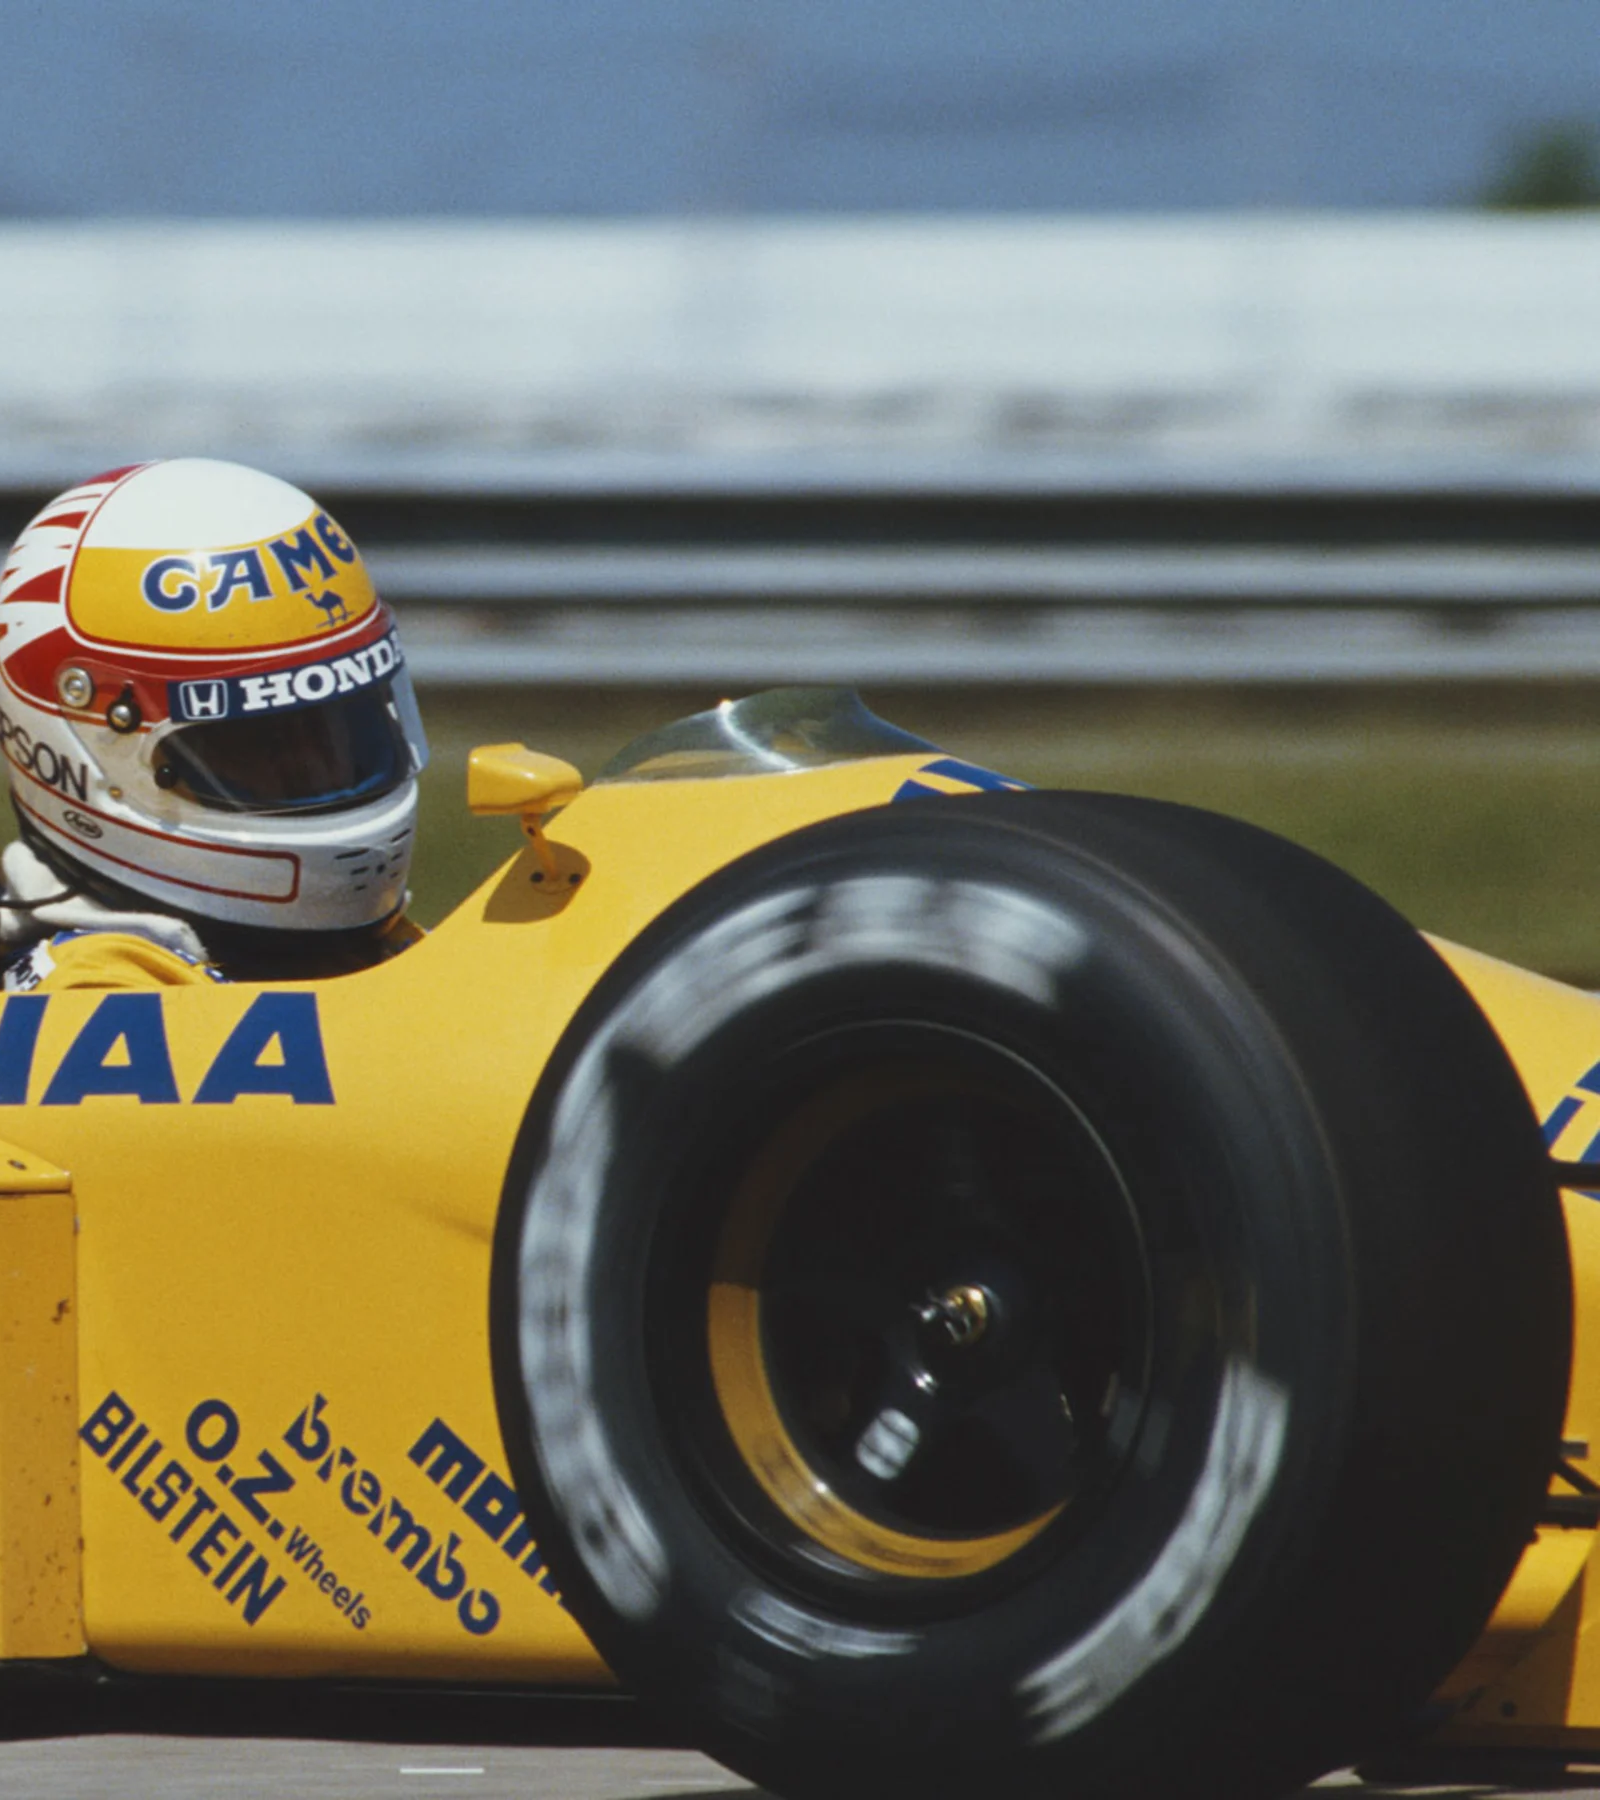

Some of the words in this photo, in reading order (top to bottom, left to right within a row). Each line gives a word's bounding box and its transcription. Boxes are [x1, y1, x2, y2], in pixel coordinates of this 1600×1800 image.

[78, 1389, 288, 1628] BILSTEIN
[185, 1398, 297, 1542] O.Z.
[284, 1525, 373, 1631] Wheels
[282, 1391, 502, 1636] brembo
